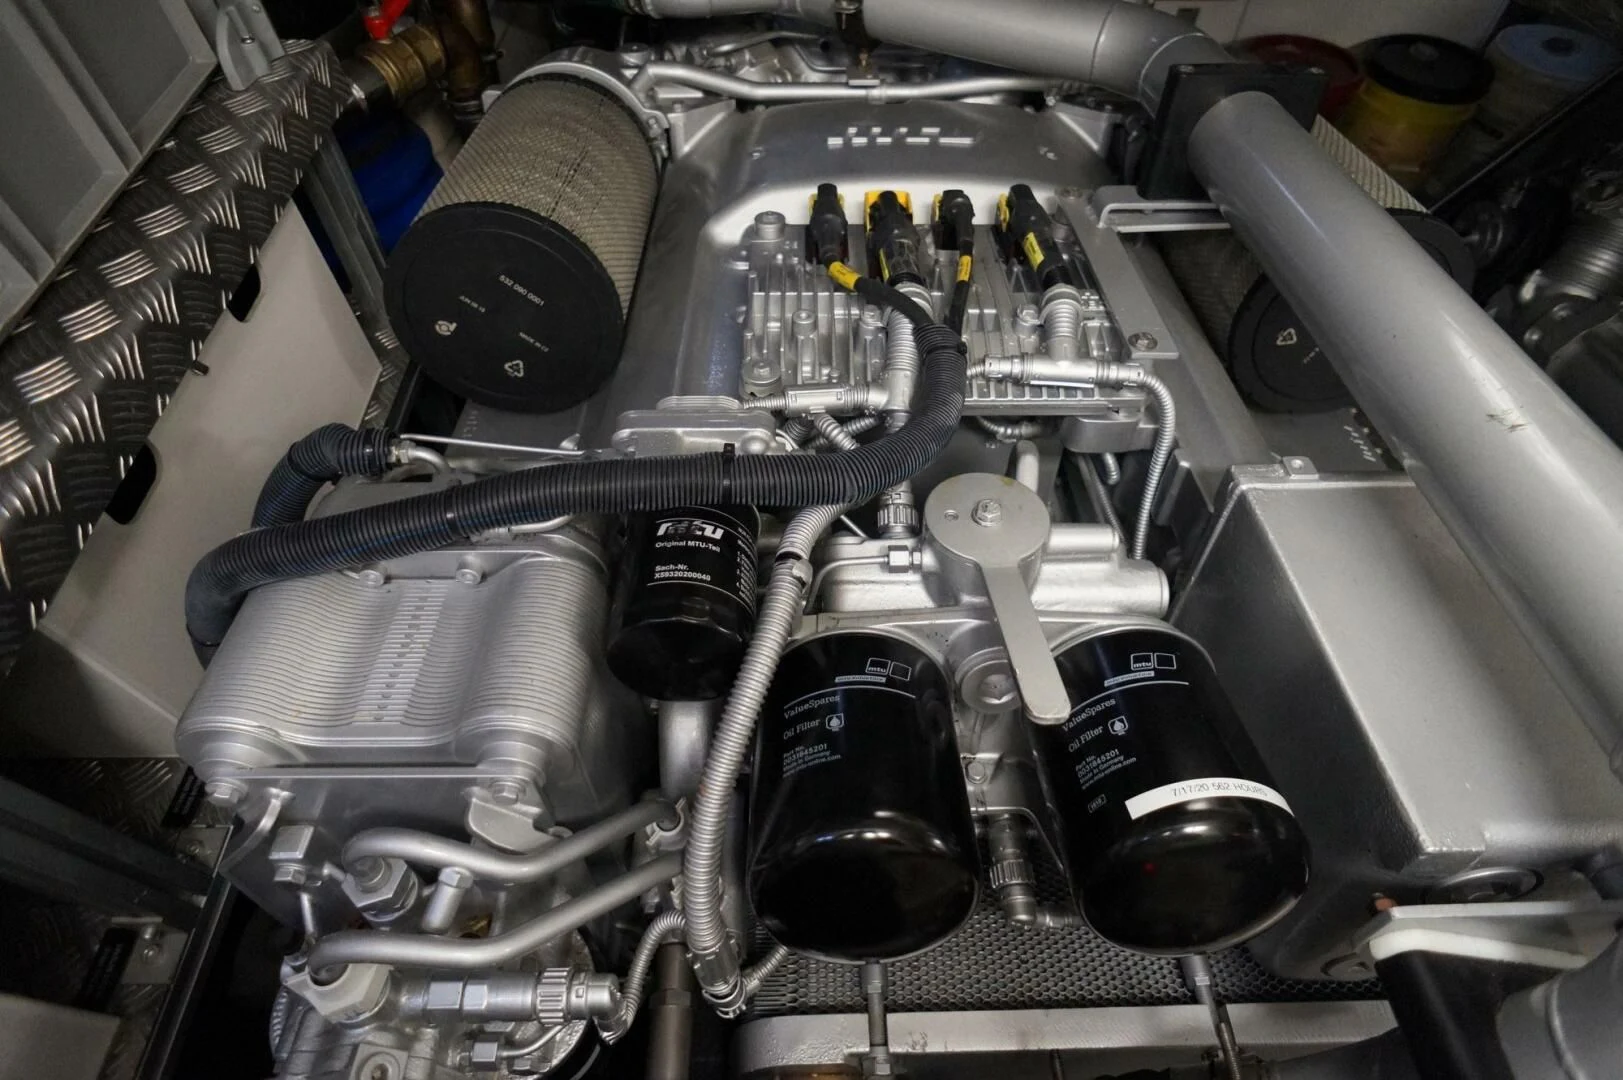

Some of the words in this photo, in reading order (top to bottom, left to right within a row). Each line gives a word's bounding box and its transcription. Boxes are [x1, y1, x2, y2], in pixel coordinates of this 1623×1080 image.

[655, 540, 686, 549] Original
[687, 540, 721, 553] MTU-Teil
[655, 563, 689, 572] Sach-Nr.
[868, 666, 887, 674] mtu
[1133, 661, 1152, 669] mtu
[783, 694, 841, 720] ValueSpares
[1062, 698, 1116, 733] ValueSpares
[783, 727, 795, 740] Oil
[796, 718, 821, 735] Filter
[1068, 739, 1080, 753] Oil
[1080, 724, 1104, 744] Filter
[1171, 784, 1210, 798] 7/17/20
[1212, 782, 1231, 791] 562
[1233, 783, 1268, 797] HOURS
